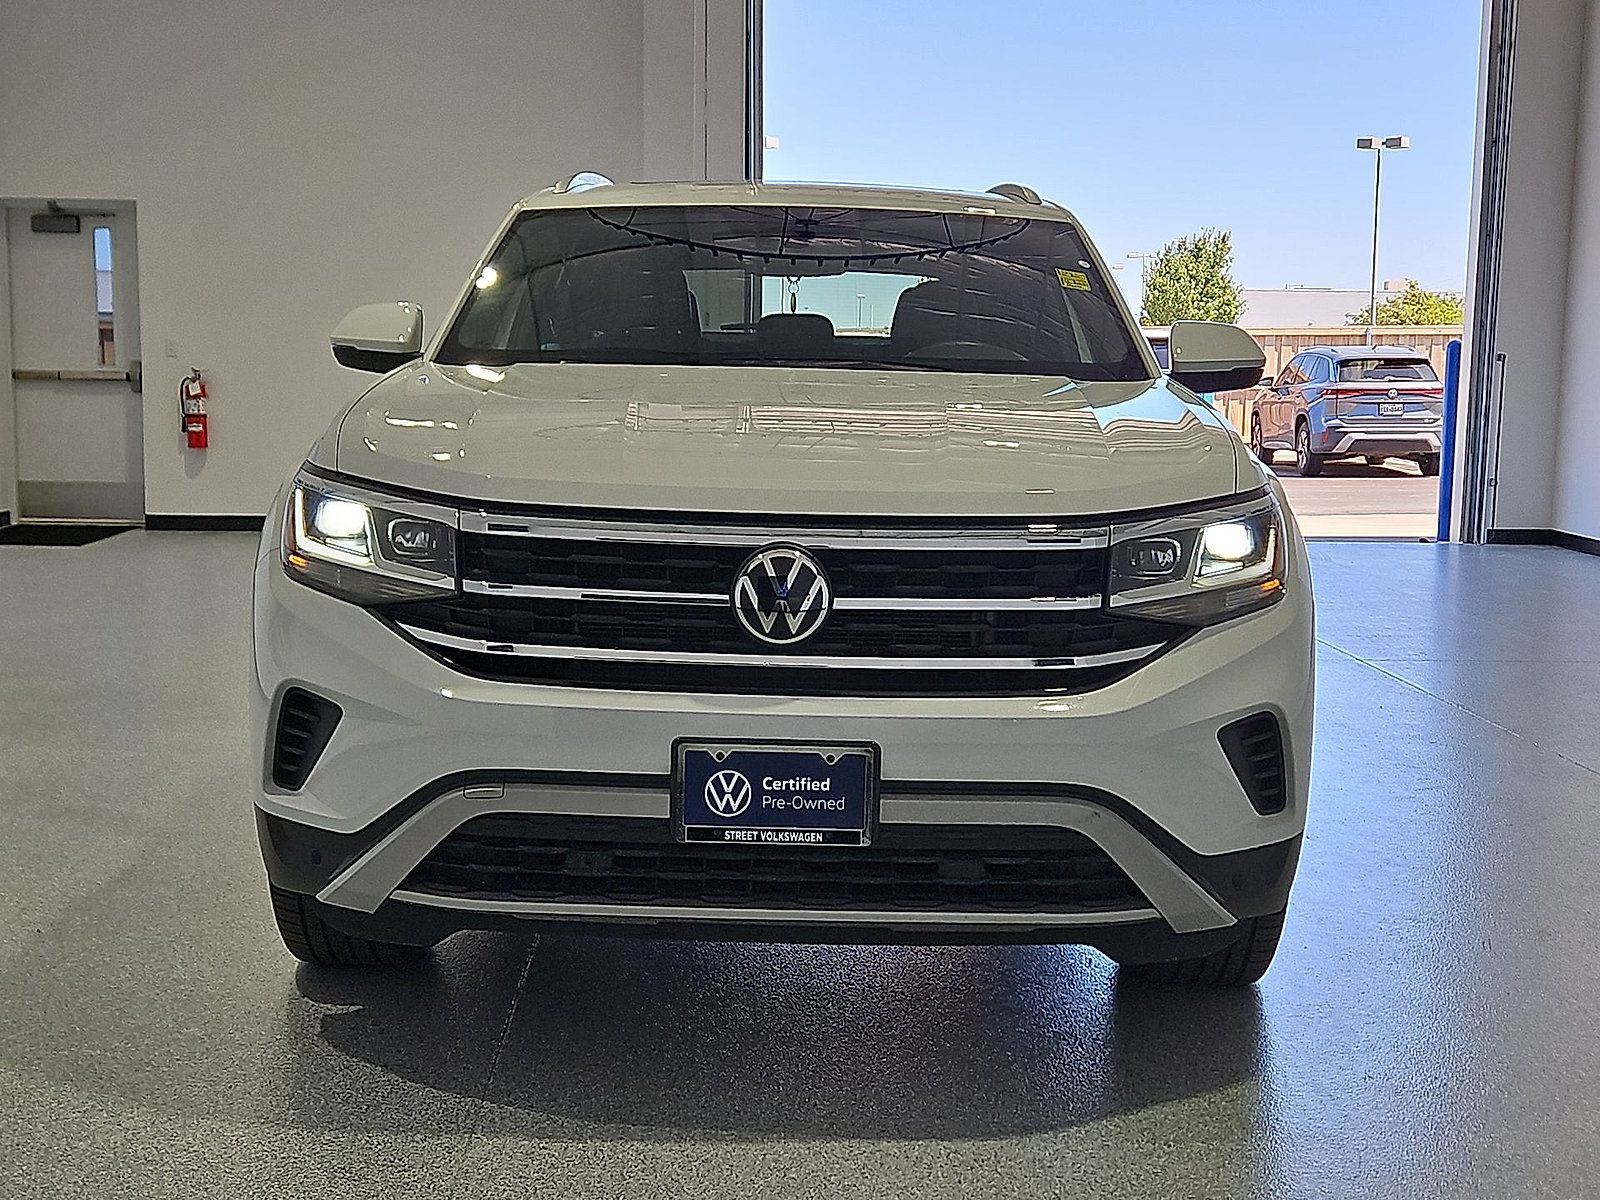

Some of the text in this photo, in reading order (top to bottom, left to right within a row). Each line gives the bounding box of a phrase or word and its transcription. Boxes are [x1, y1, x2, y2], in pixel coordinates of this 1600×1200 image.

[762, 776, 831, 791] Certified
[705, 770, 752, 817] VW
[762, 795, 845, 811] Pre-Owned
[724, 830, 823, 843] STREET VOLKSWAGEN
